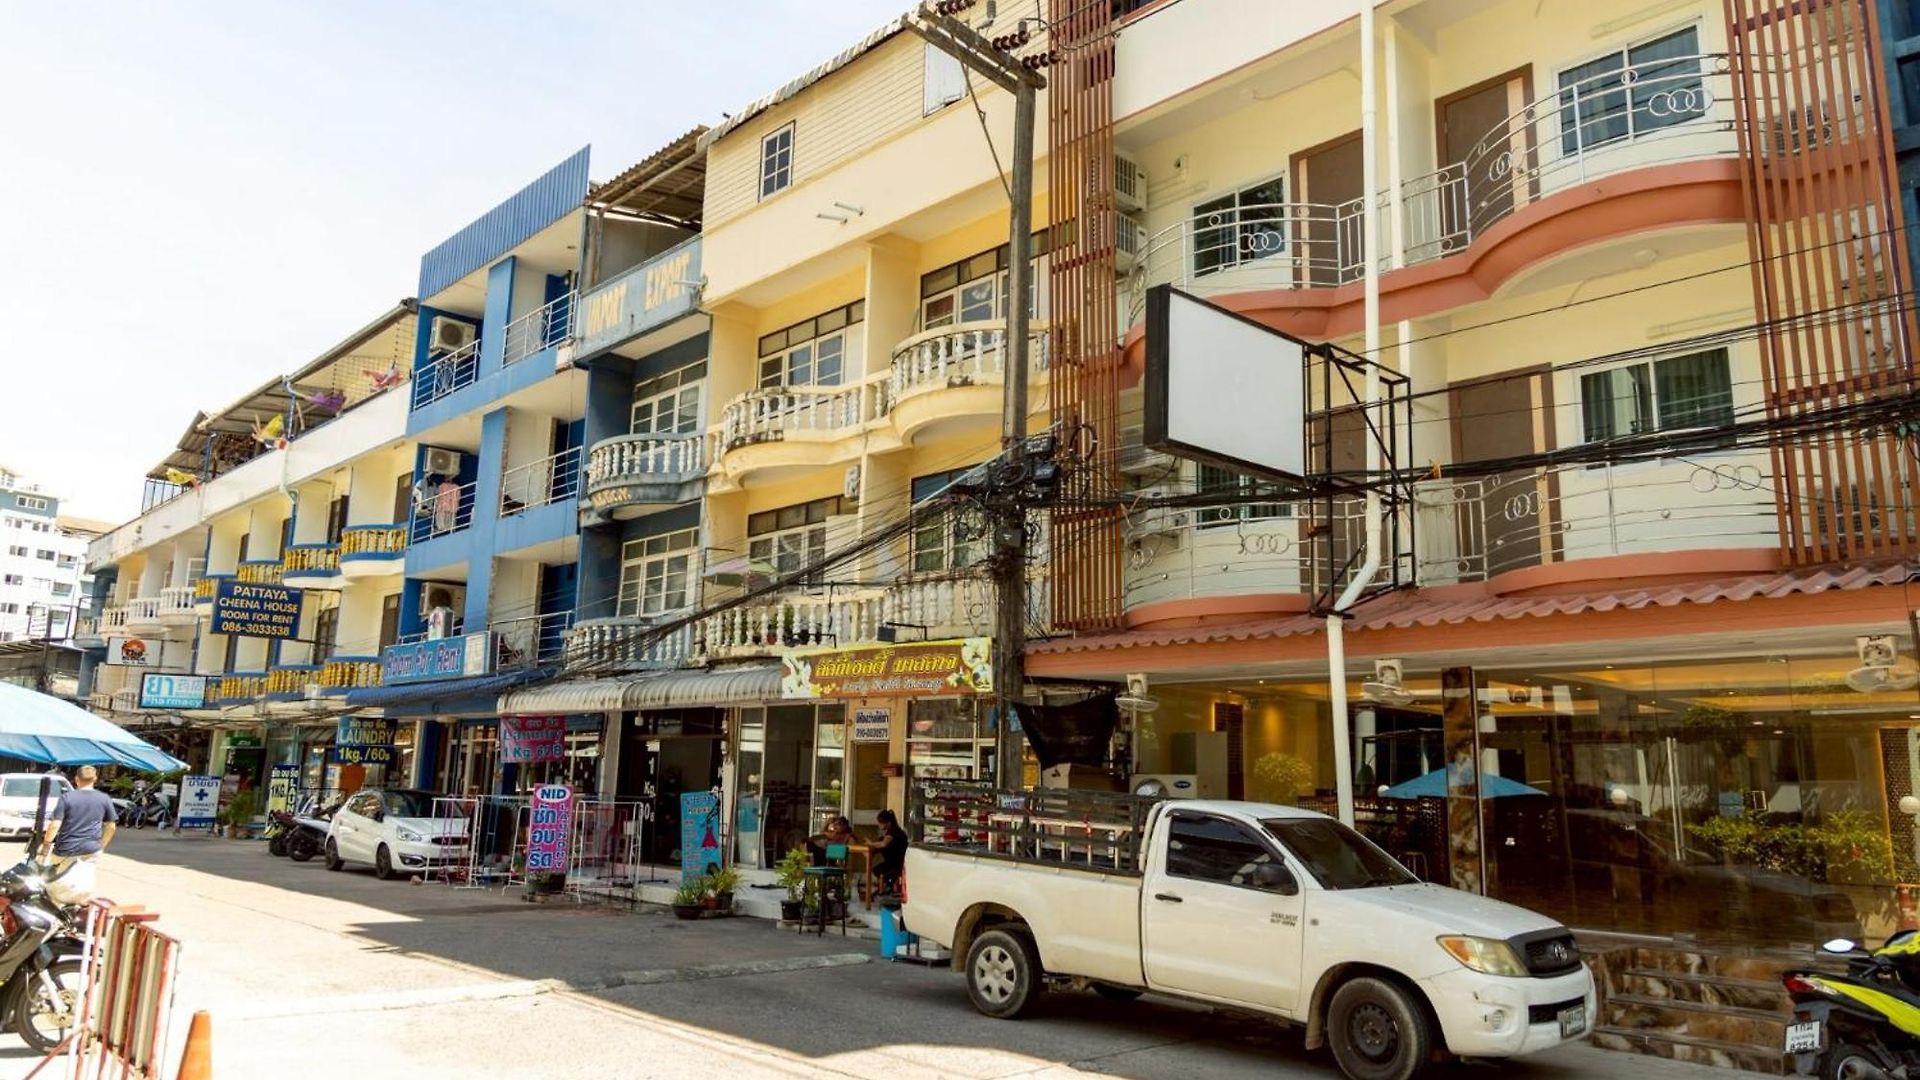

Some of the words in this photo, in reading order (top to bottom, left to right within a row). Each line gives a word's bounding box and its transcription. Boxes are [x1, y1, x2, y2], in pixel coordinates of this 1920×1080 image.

[645, 252, 690, 311] EXPORT
[233, 585, 288, 600] PATTAYA
[219, 597, 260, 609] CHEENA
[263, 602, 298, 613] HOUSE
[220, 610, 249, 620] ROOM
[252, 613, 270, 622] FOR
[272, 615, 294, 625] RENT
[386, 649, 413, 676] Room
[415, 644, 433, 675] For
[436, 642, 463, 674] Rent
[146, 676, 174, 697] ยา
[143, 697, 203, 708] Pharmacy
[338, 729, 395, 745] LAUNDRY
[648, 756, 655, 775] 1
[541, 789, 567, 799] NID
[531, 829, 555, 844] อบ
[529, 847, 553, 867] รีด
